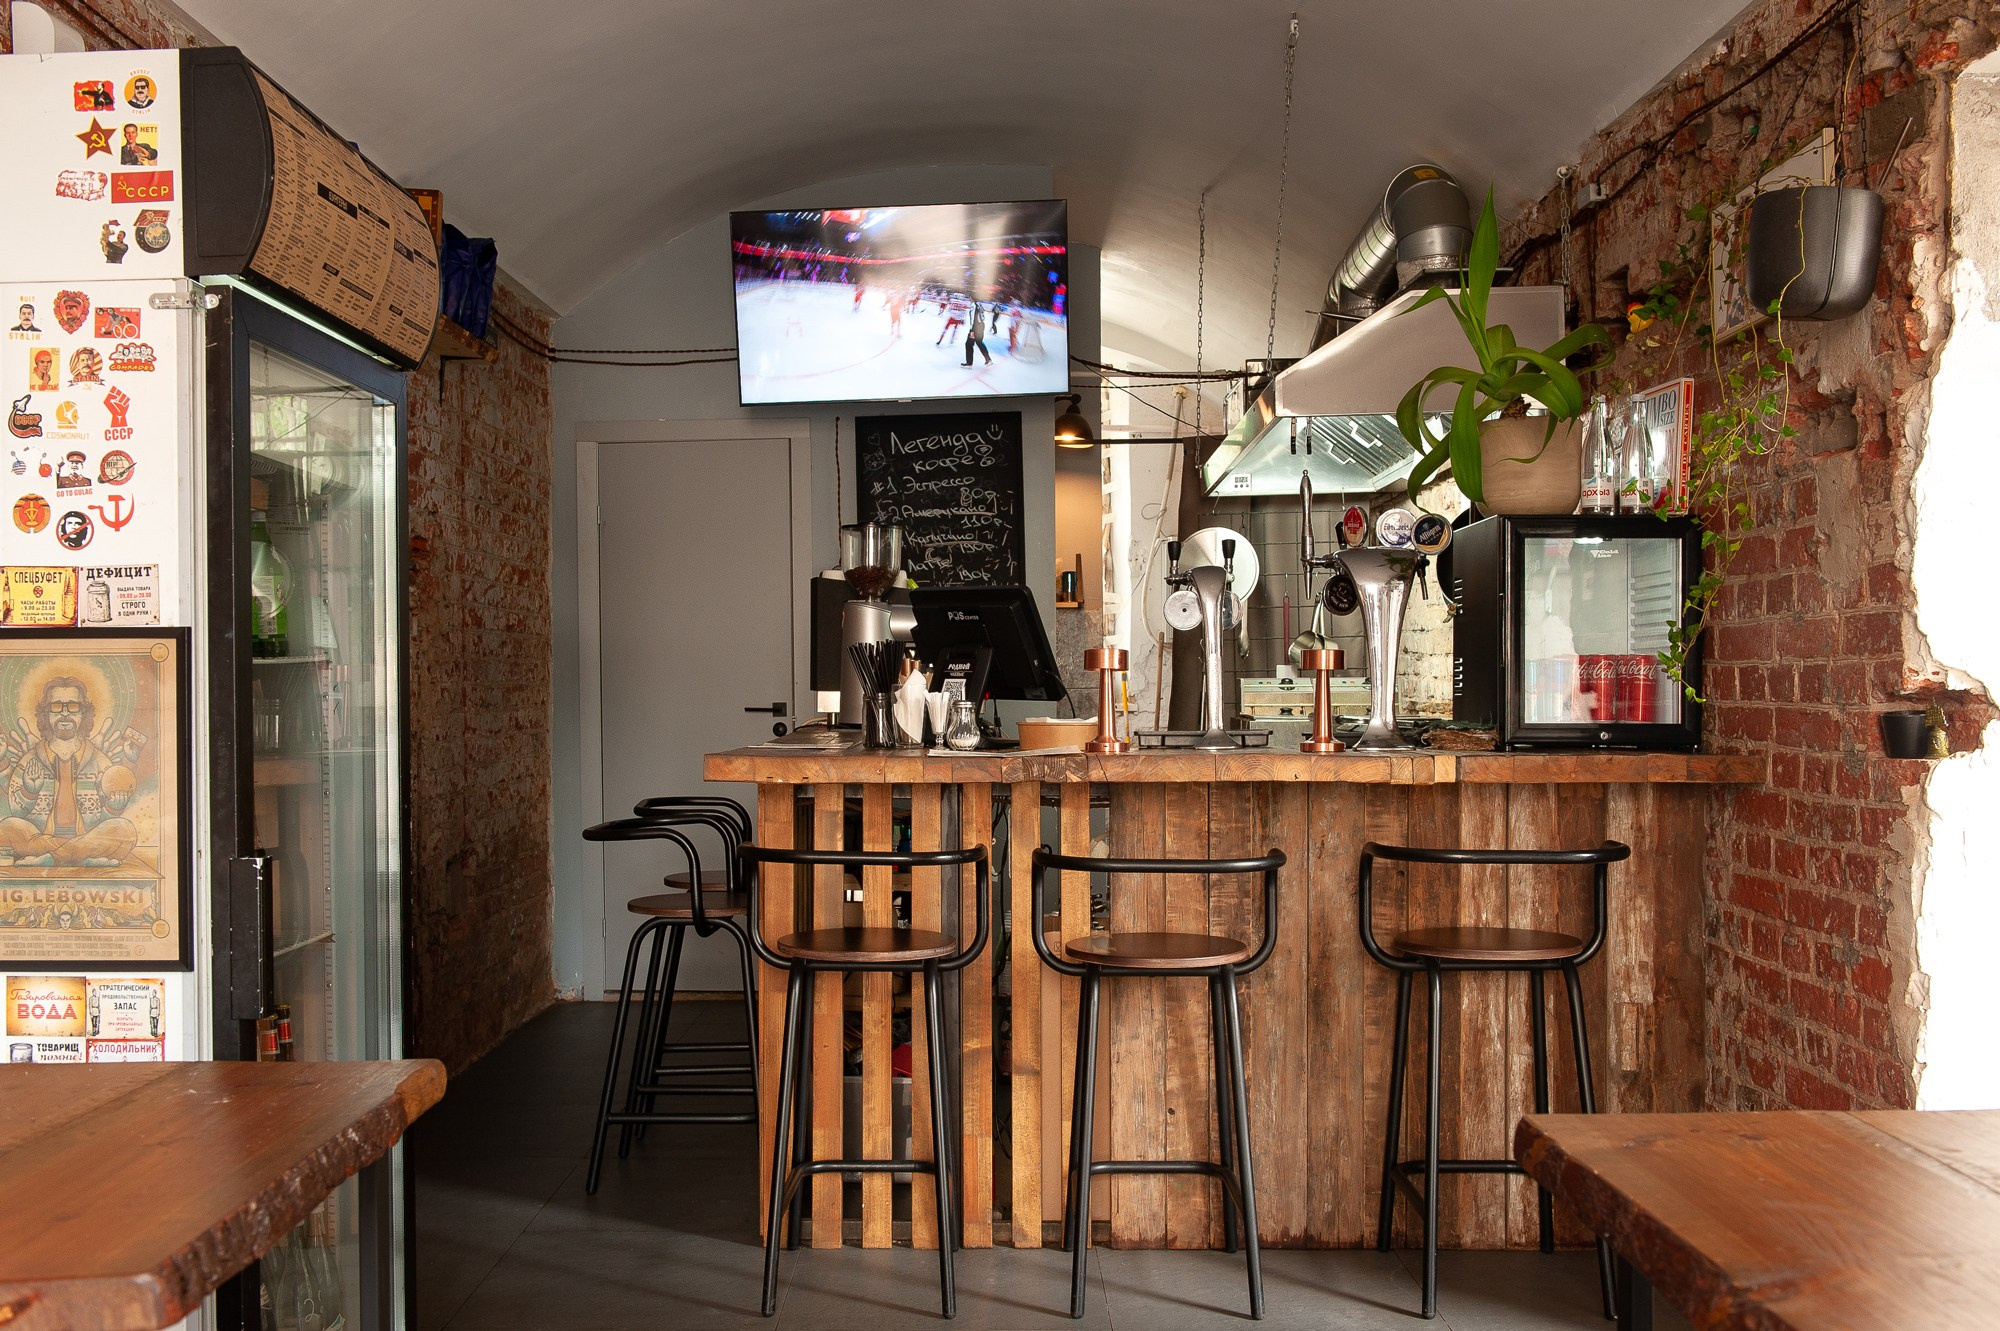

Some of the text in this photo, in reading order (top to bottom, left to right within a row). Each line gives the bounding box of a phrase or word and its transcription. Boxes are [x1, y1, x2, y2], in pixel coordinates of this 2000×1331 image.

[126, 185, 169, 198] СССР
[73, 374, 99, 383] STALIN
[1660, 410, 1675, 427] SIZE
[46, 431, 90, 440] COSMONAUT
[104, 427, 134, 442] СССР
[890, 431, 986, 457] Легенда
[913, 455, 975, 474] кофе
[56, 488, 93, 498] GO TO GULAG
[14, 571, 63, 585] СПЕЦБУФЕТ
[86, 566, 152, 581] ДЕФИЦИТ
[121, 601, 146, 609] СТРОГО
[1, 889, 144, 904] IG LEBOWSKI
[99, 984, 150, 992] СТРАТЕГИЧЕСКИЙ
[10, 988, 83, 1003] Газированная
[17, 1003, 78, 1020] ВОДА
[113, 1002, 137, 1011] ЗАПАС
[36, 1043, 80, 1053] ТОВАРИЩ
[92, 1043, 158, 1055] ХОЛОДИЛЬНИК
